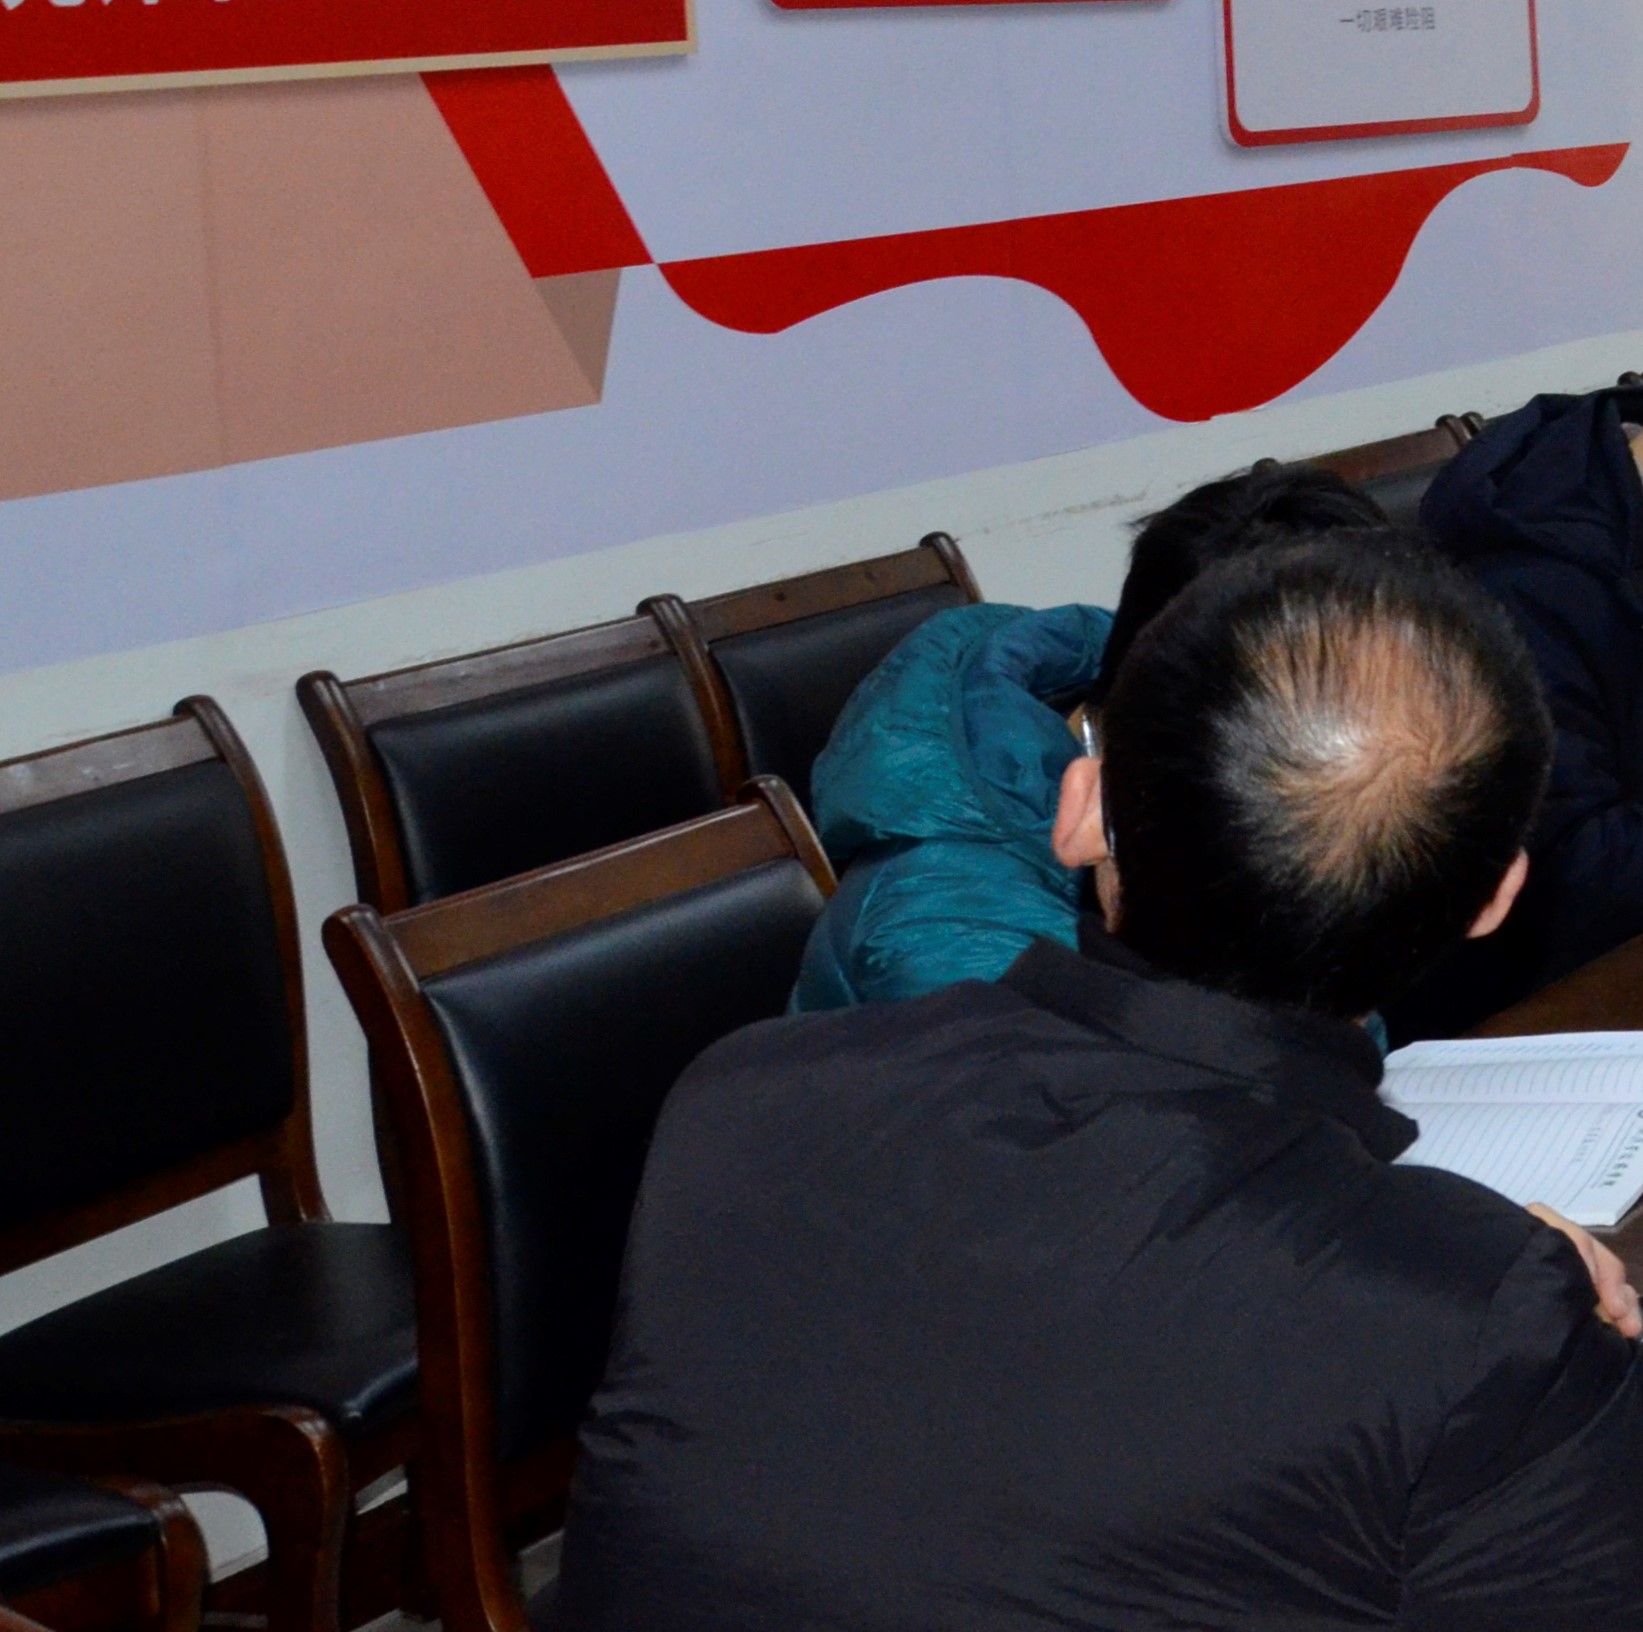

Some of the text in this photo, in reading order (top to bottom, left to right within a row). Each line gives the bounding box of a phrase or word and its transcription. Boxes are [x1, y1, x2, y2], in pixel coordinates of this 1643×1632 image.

[1339, 6, 1436, 33] 一切艰难险阻
